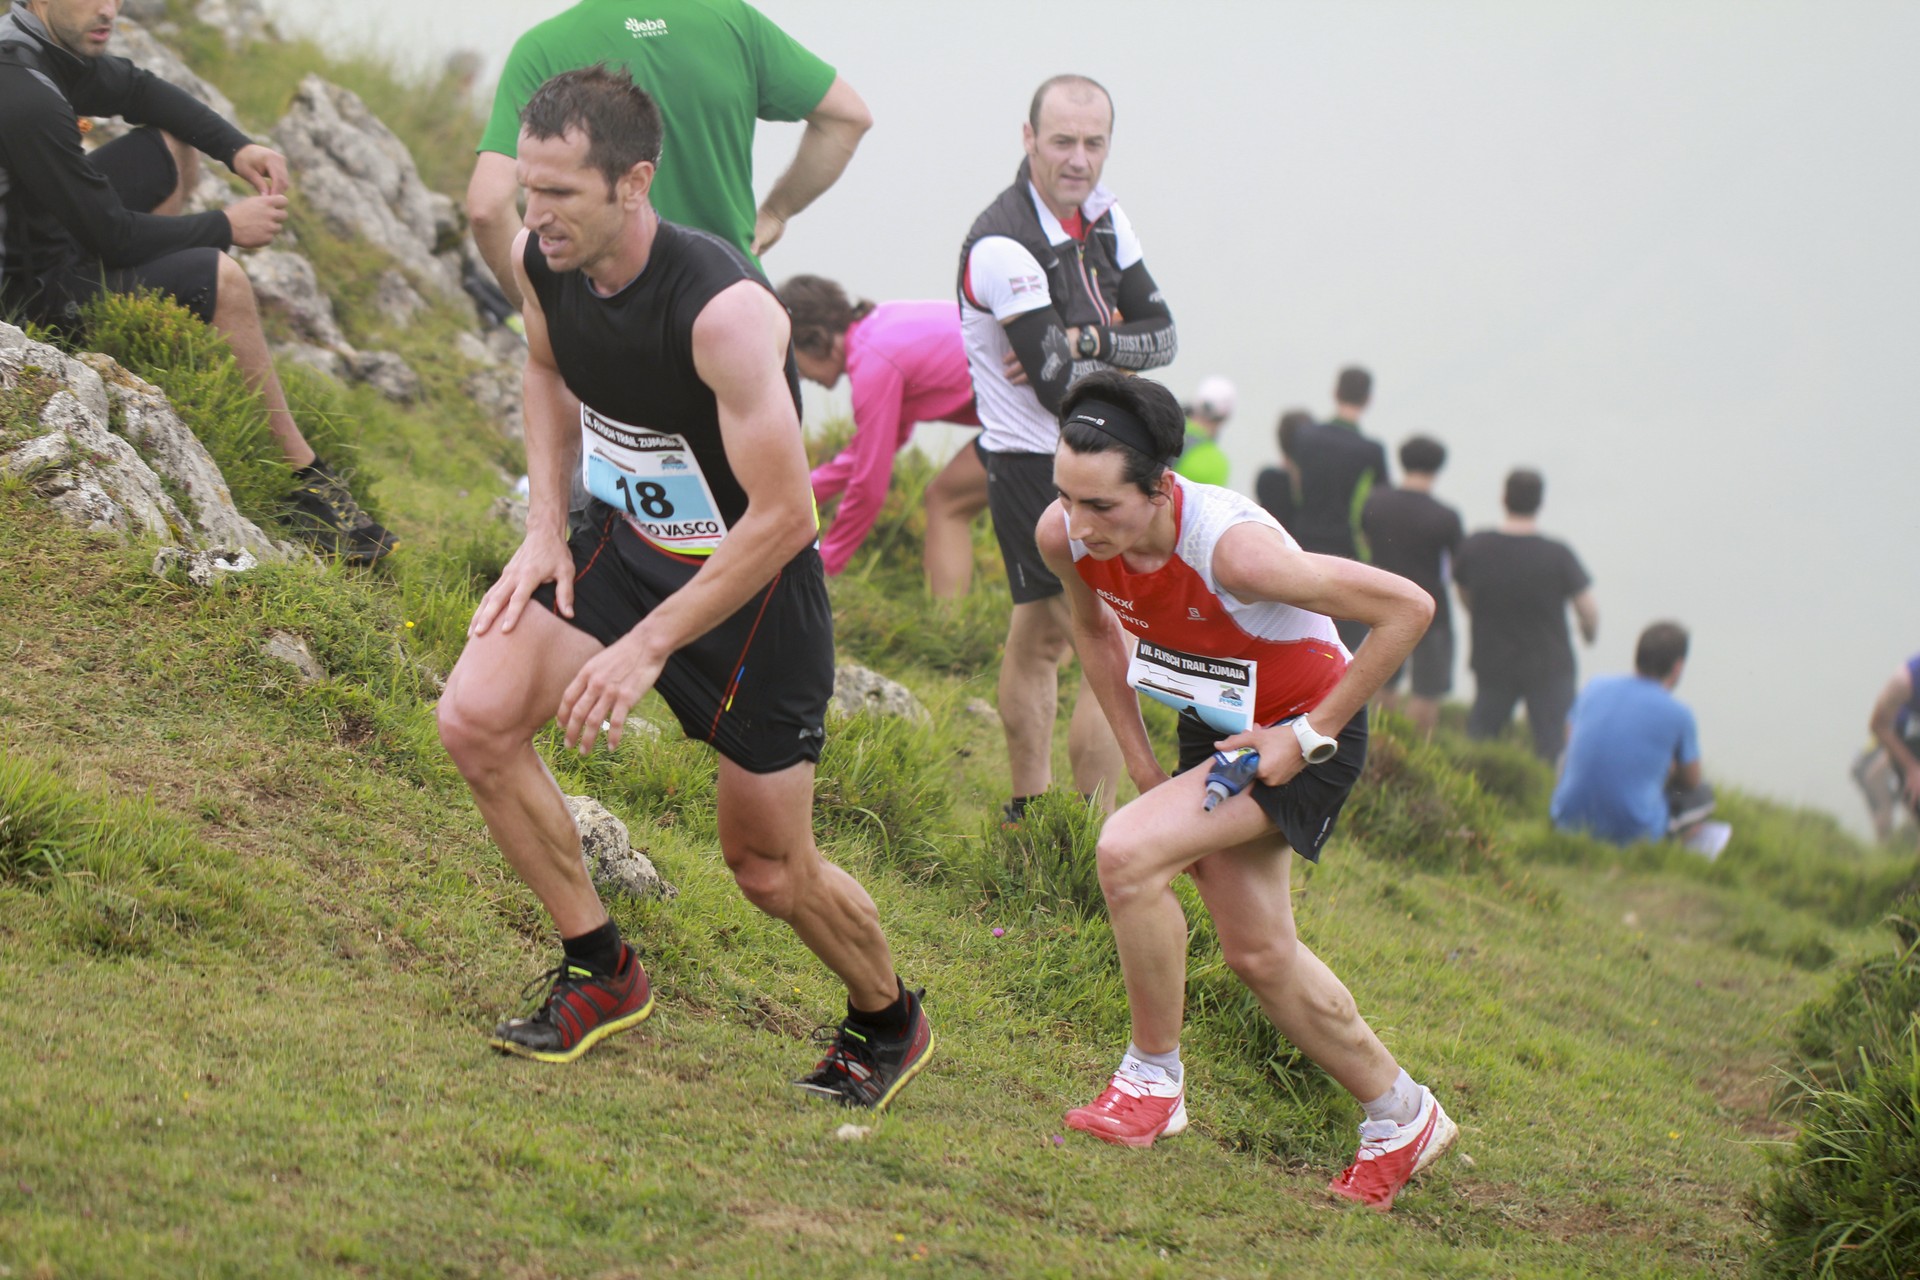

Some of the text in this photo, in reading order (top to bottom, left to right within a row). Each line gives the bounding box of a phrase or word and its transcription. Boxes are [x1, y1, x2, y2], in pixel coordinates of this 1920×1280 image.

[630, 17, 667, 33] deba
[616, 476, 675, 519] 18
[661, 521, 719, 537] VASCO
[1154, 647, 1181, 668] FLYSCH
[1181, 658, 1208, 674] TRAIL
[1208, 663, 1247, 681] ZUMAIA
